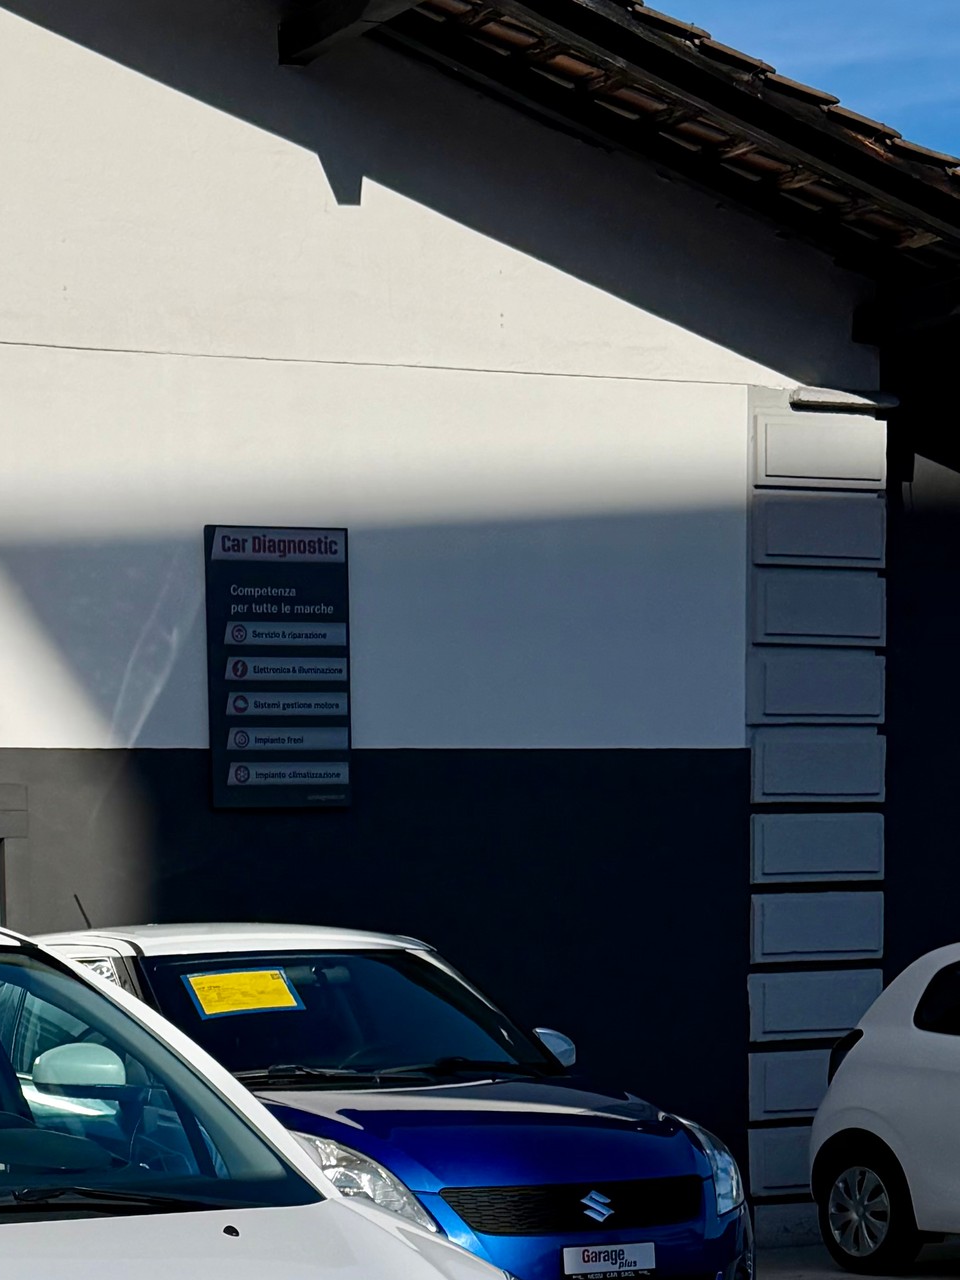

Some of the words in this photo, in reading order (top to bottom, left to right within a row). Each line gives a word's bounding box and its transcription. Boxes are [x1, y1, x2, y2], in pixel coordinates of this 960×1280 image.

[221, 534, 248, 553] Car
[251, 534, 339, 558] Diagnostic
[230, 584, 297, 598] Competenza
[230, 603, 249, 615] per
[252, 602, 278, 614] tutte
[281, 602, 291, 614] le
[294, 603, 334, 614] marche
[251, 629, 281, 639] Servizio
[253, 701, 281, 710] Sistemi
[281, 701, 313, 712] gestione
[313, 702, 340, 710] motore
[254, 736, 286, 746] Impianto
[287, 735, 305, 744] freni
[255, 770, 287, 781] Impianto
[582, 1249, 625, 1265] Garage
[619, 1259, 637, 1269] plus
